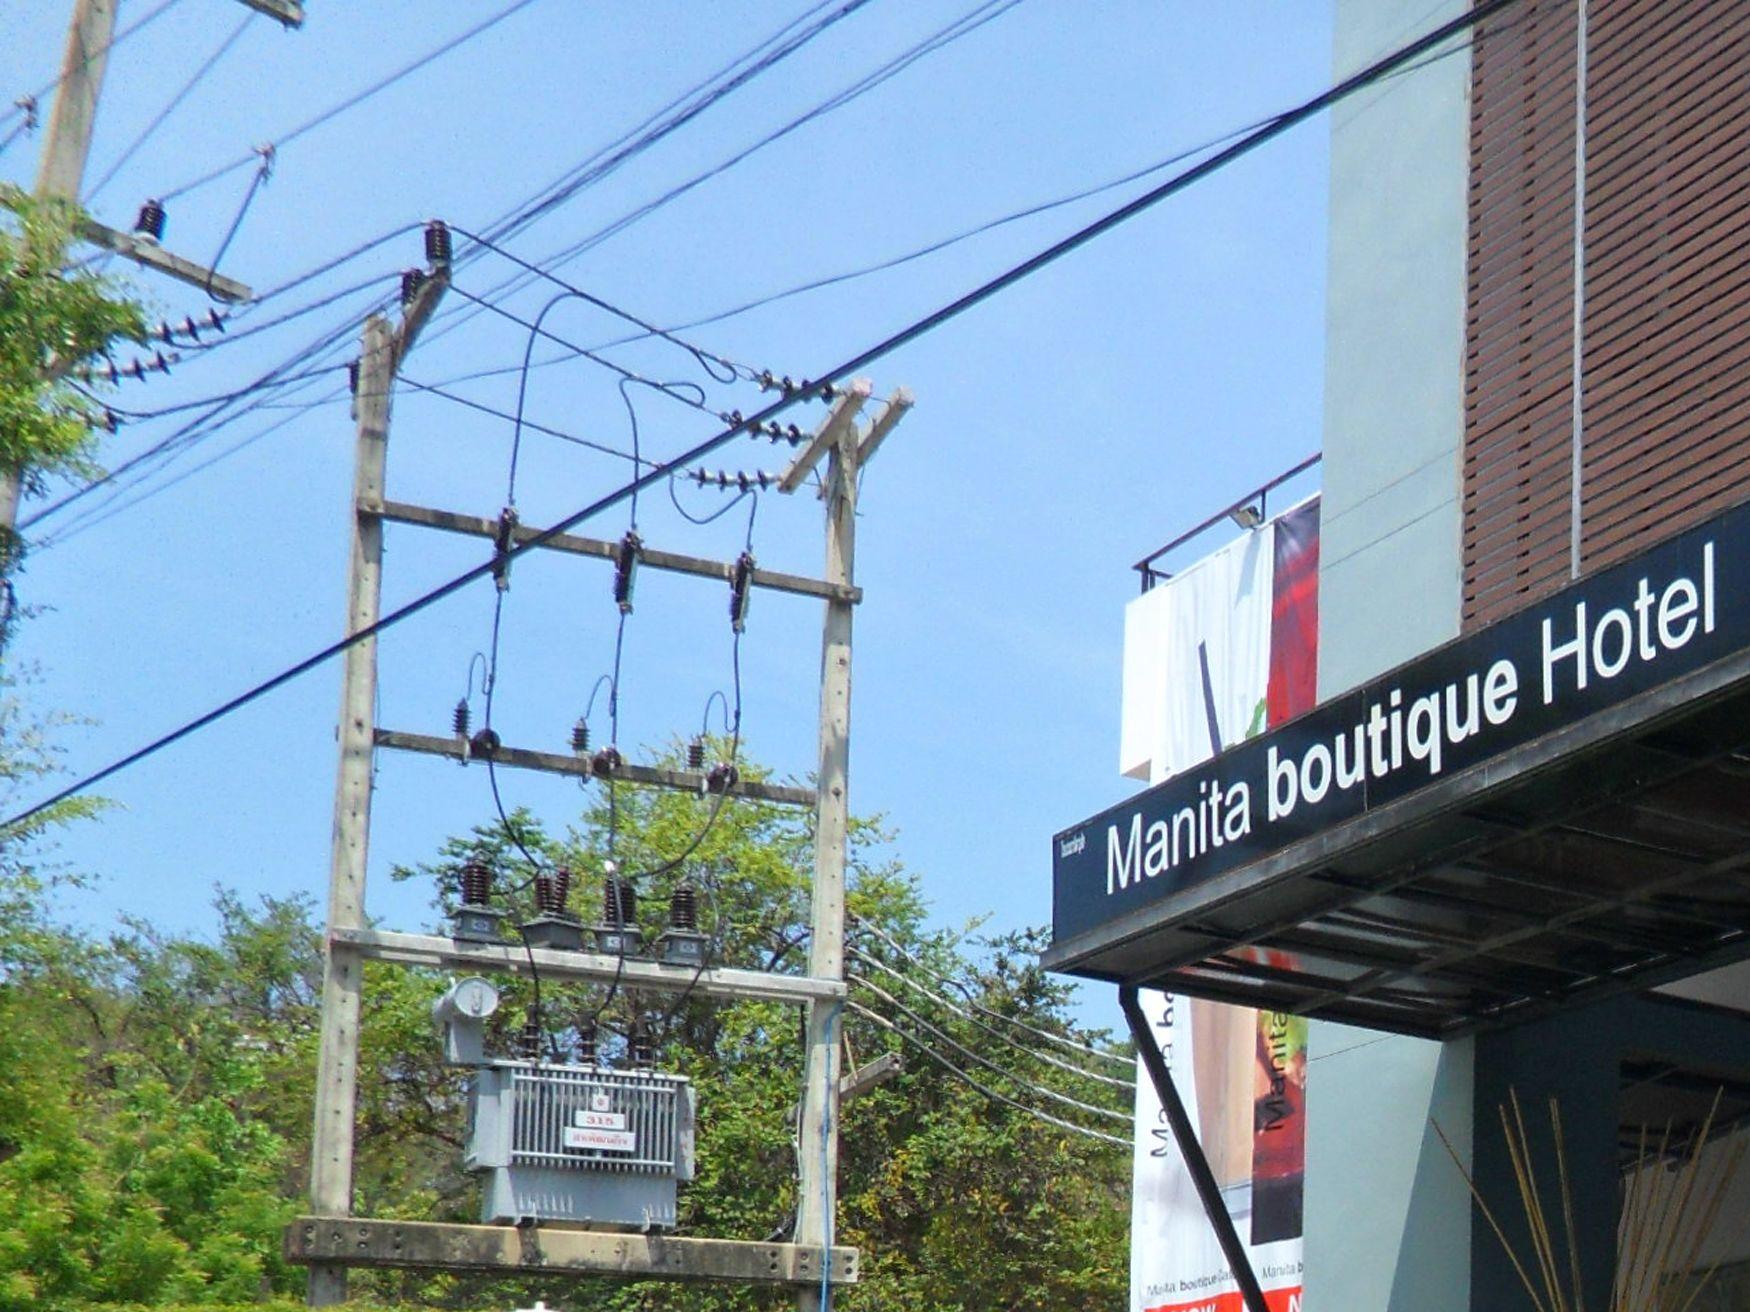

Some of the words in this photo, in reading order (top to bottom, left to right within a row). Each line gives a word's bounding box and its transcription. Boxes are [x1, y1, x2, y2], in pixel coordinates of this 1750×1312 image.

[1105, 772, 1252, 895] Manita
[1266, 658, 1519, 824] boutique
[1541, 541, 1716, 704] Hotel
